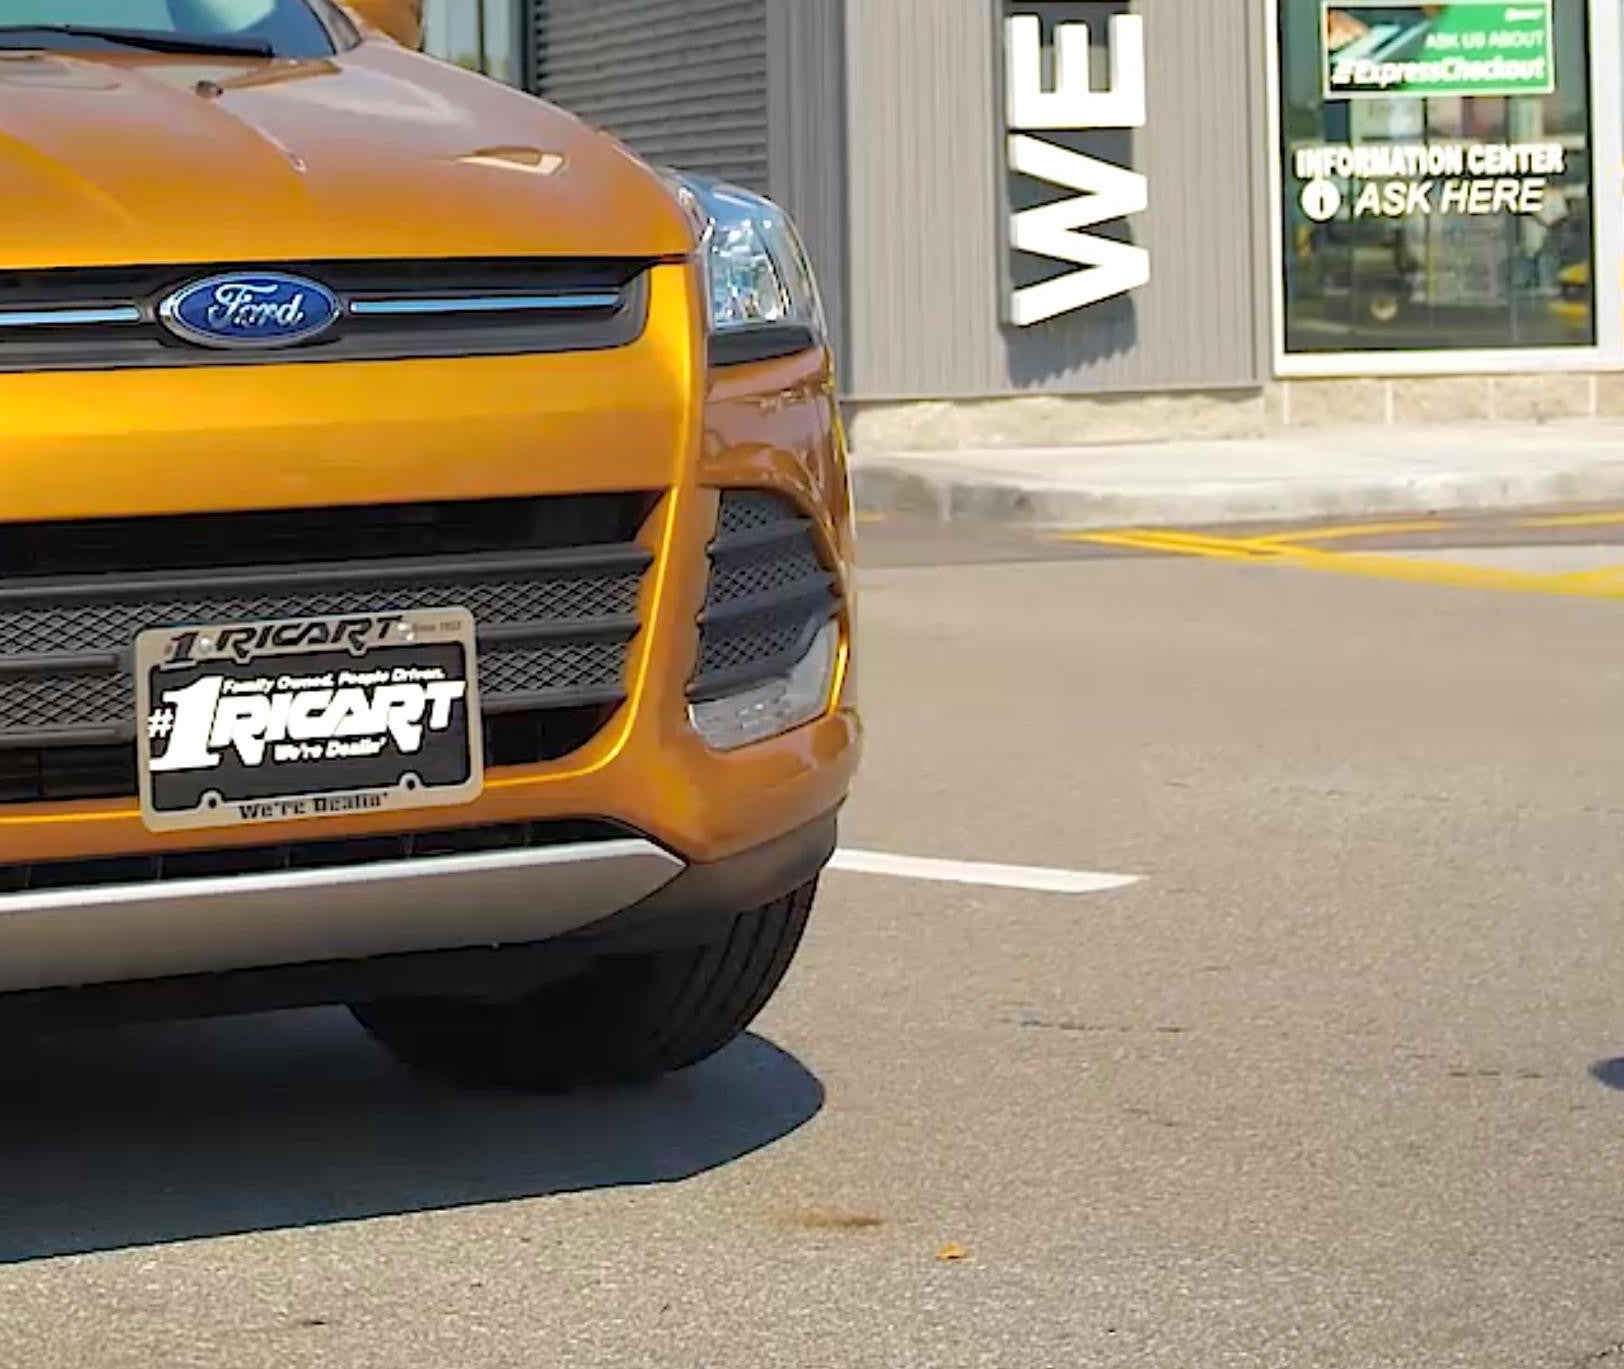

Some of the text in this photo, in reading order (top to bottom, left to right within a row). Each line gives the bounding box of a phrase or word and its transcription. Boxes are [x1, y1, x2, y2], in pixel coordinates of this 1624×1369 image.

[1426, 29, 1544, 49] ASK US ABOUT
[1331, 53, 1546, 89] #ExpressCheckout
[1296, 141, 1566, 179] INFORMATION CENTER
[1354, 177, 1547, 219] ASK HERE
[208, 282, 305, 330] Ford
[222, 678, 275, 694] Family
[337, 668, 390, 686] People
[238, 800, 306, 820] We're
